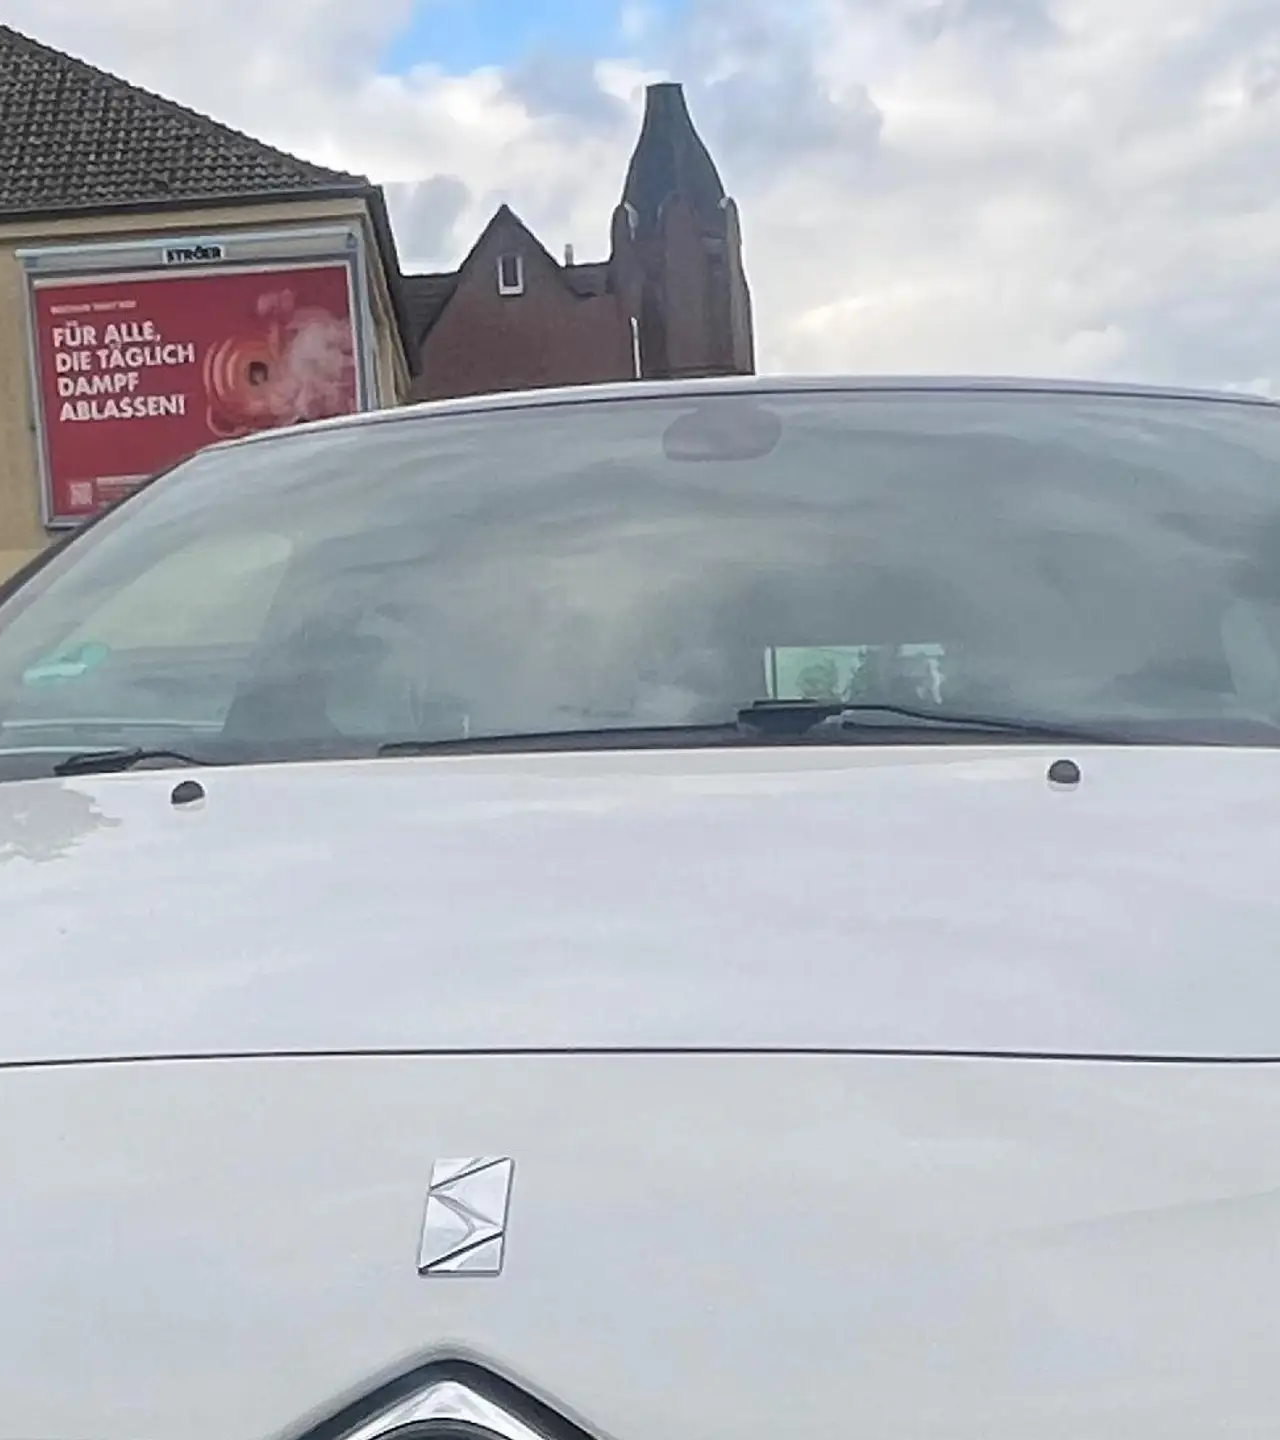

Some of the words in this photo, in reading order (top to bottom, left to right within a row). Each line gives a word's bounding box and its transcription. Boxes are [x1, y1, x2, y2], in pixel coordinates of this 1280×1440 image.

[52, 320, 97, 347] FÜR
[104, 320, 161, 344] ALLE,
[55, 351, 92, 373] DIE
[96, 342, 195, 369] TÄGLICH
[57, 372, 139, 397] DAMPF
[59, 394, 185, 421] ABLASSEN!
